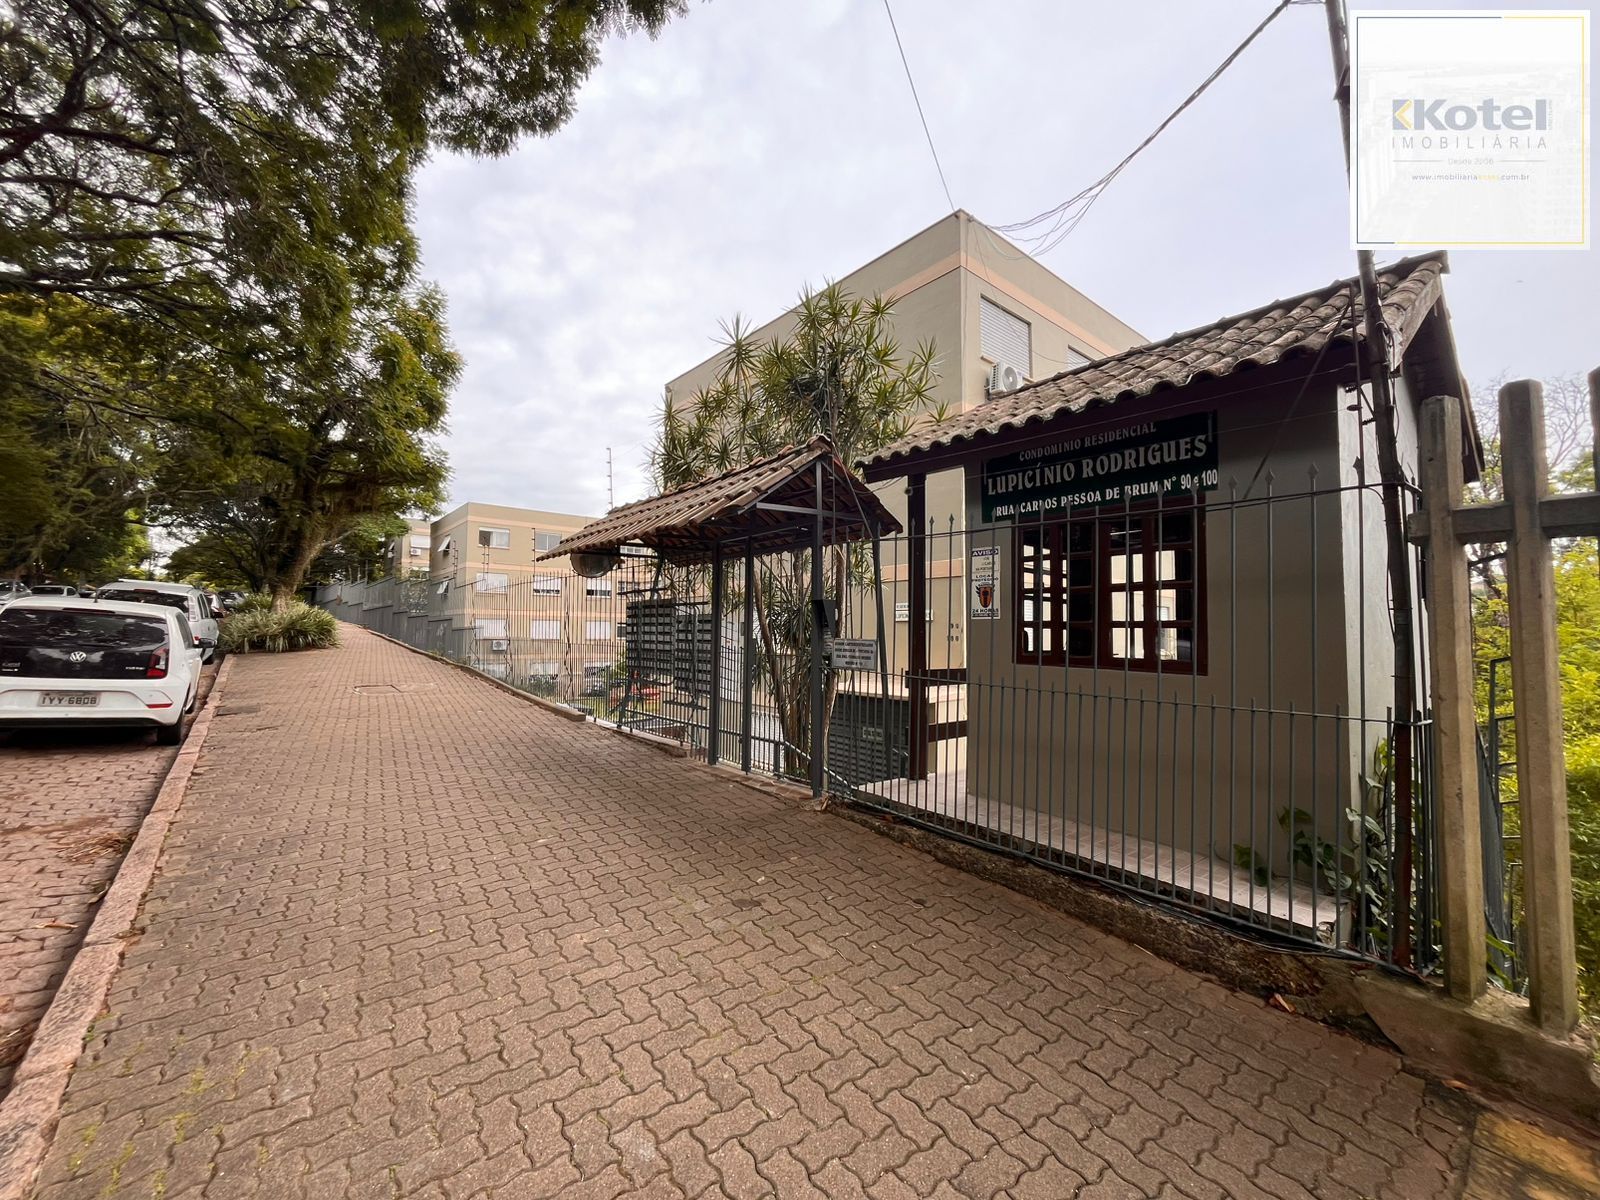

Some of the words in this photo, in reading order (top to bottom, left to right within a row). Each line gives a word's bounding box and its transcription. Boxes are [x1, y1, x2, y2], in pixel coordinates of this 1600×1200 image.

[1084, 421, 1157, 448] RESIDENCIAL
[987, 462, 1075, 496] LUPICÍNIO
[1082, 434, 1208, 478] RODRIGUES
[996, 504, 1015, 517] RUA
[1060, 490, 1102, 507] PESSOA
[1105, 487, 1120, 500] DE
[1124, 480, 1159, 496] BRUM
[1180, 473, 1192, 490] 90
[1201, 469, 1218, 487] 100
[972, 548, 998, 557] AVISO
